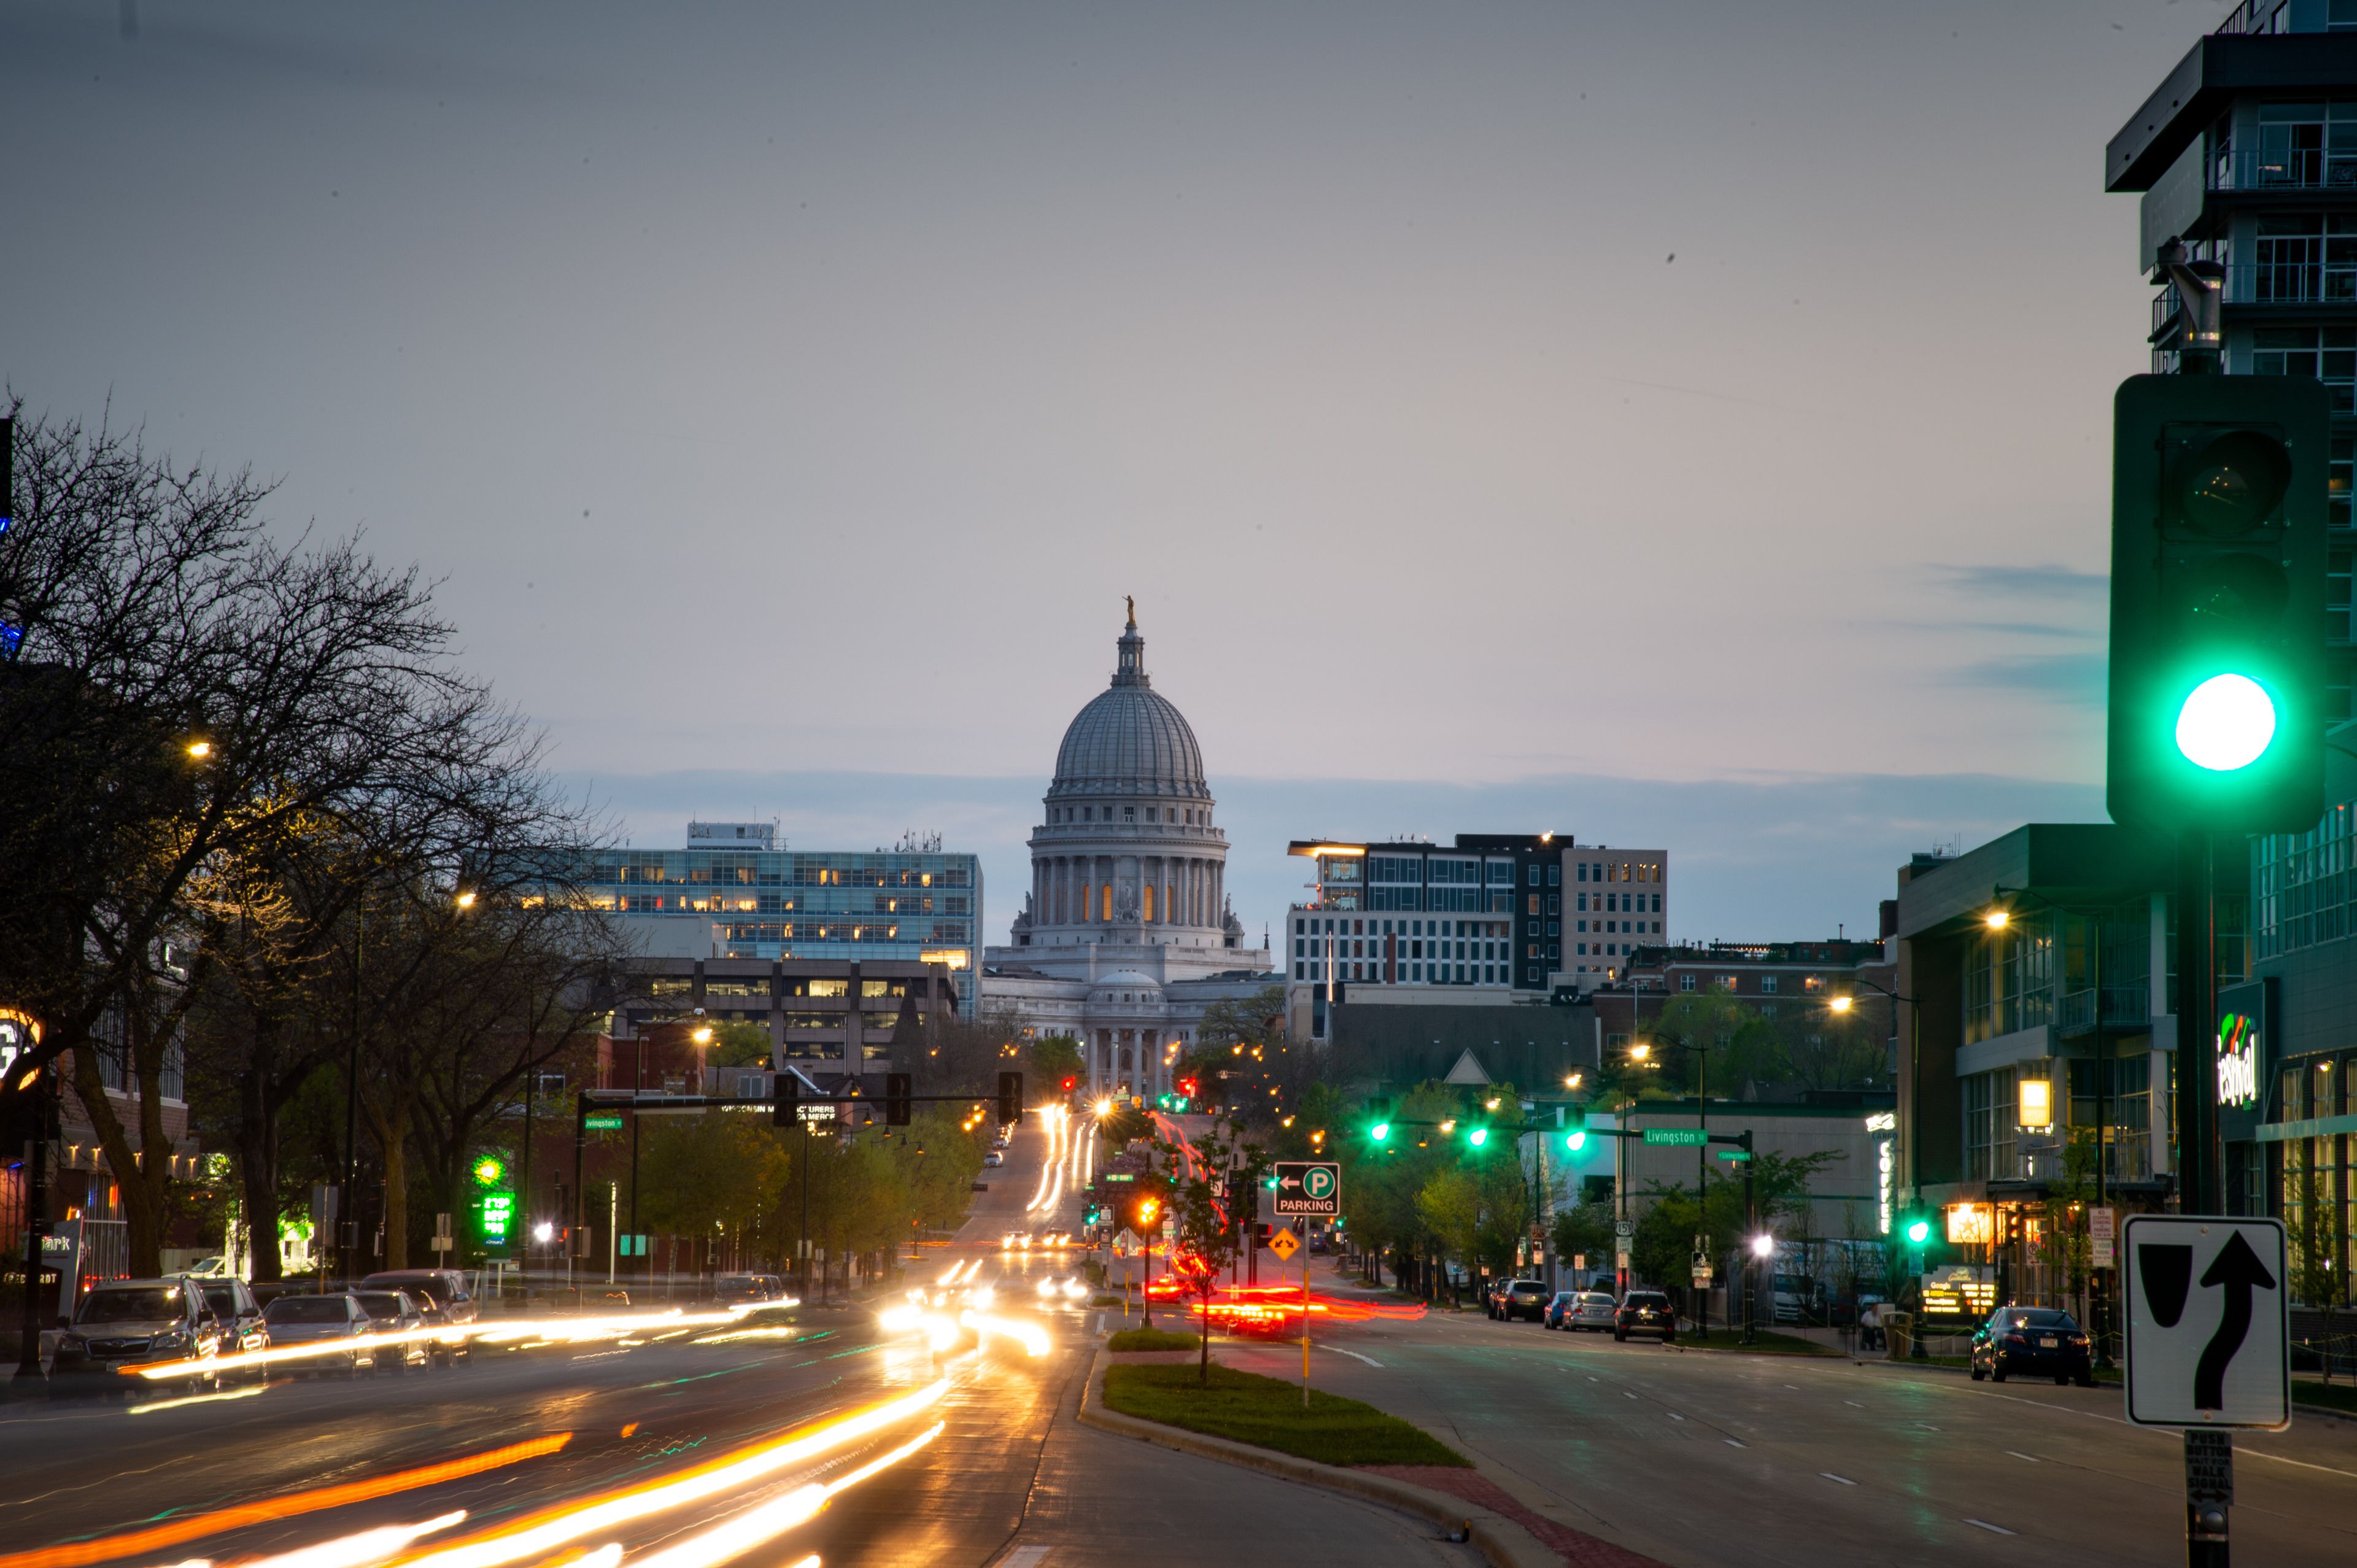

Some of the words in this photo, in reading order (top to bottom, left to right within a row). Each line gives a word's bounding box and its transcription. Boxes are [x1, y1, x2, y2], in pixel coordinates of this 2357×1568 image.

[2217, 1033, 2255, 1106] estival
[586, 1120, 615, 1129] ivingston
[1647, 1130, 1695, 1146] Livingston
[1312, 1173, 1328, 1194] P
[1879, 1141, 1891, 1234] COFFEE
[1280, 1200, 1333, 1211] PARKING
[1930, 1281, 1951, 1290] Google
[2191, 1433, 2226, 1444] PUSH
[2187, 1445, 2231, 1456] BUTTON
[2193, 1466, 2226, 1477] WALK
[2188, 1477, 2231, 1489] SIGNAL
